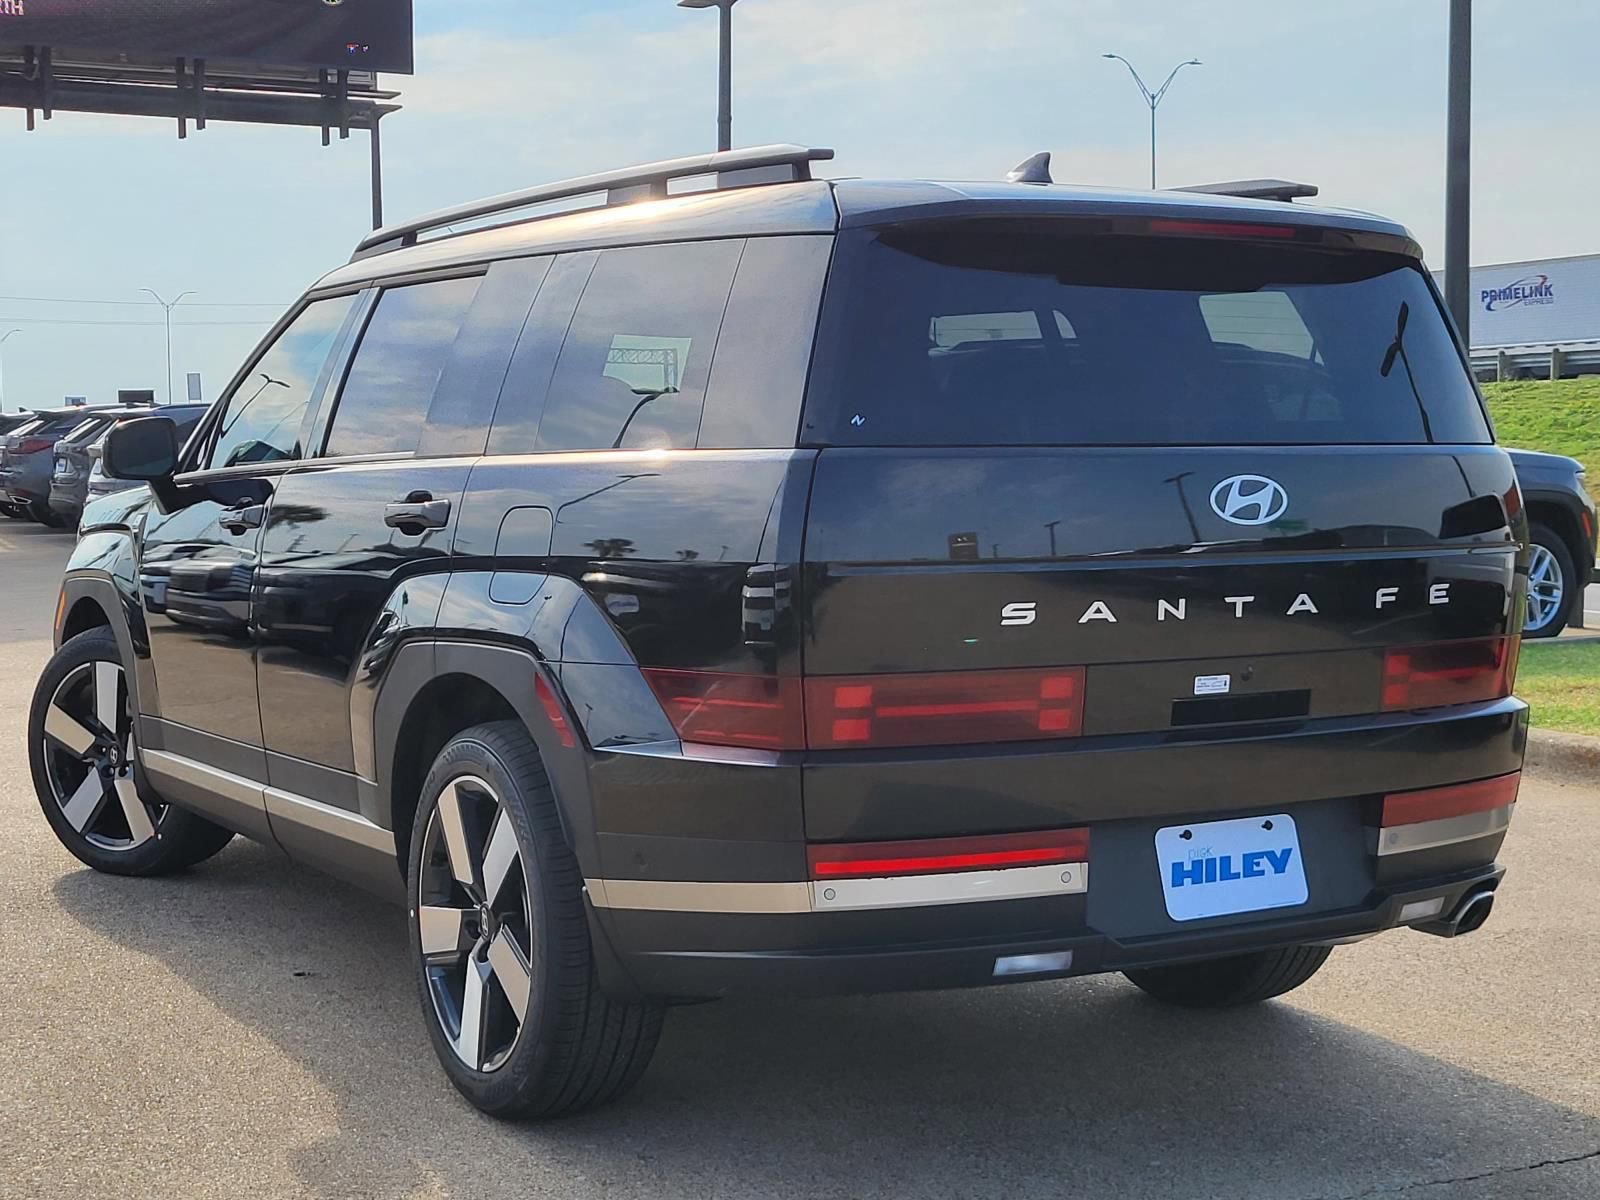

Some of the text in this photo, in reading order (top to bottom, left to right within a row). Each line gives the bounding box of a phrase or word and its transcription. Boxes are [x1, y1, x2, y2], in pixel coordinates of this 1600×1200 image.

[1481, 284, 1553, 302] PRIMELINK
[1001, 583, 1450, 625] SANTA FE
[1172, 848, 1292, 887] HILEY
